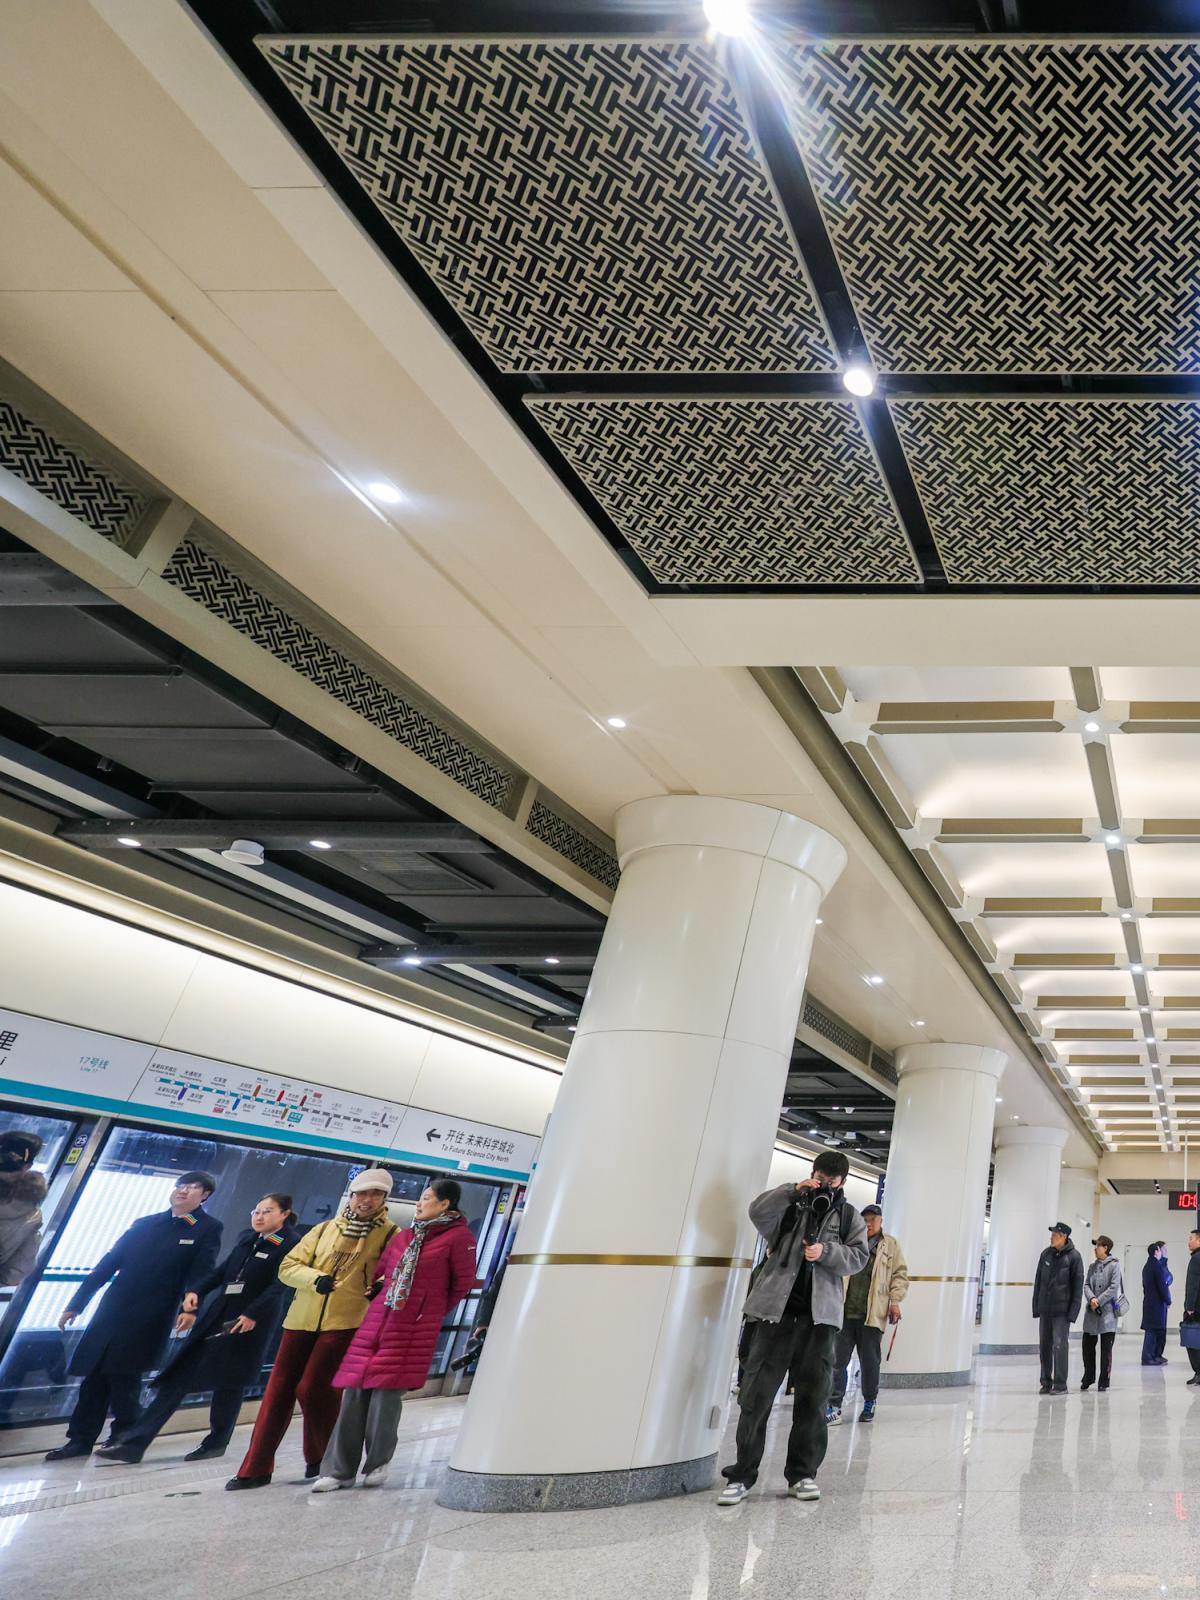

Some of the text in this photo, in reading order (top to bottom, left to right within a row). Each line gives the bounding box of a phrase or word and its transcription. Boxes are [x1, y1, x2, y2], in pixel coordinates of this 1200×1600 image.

[80, 1056, 109, 1070] 17号线
[445, 1129, 514, 1154] 开往 未来科学城北
